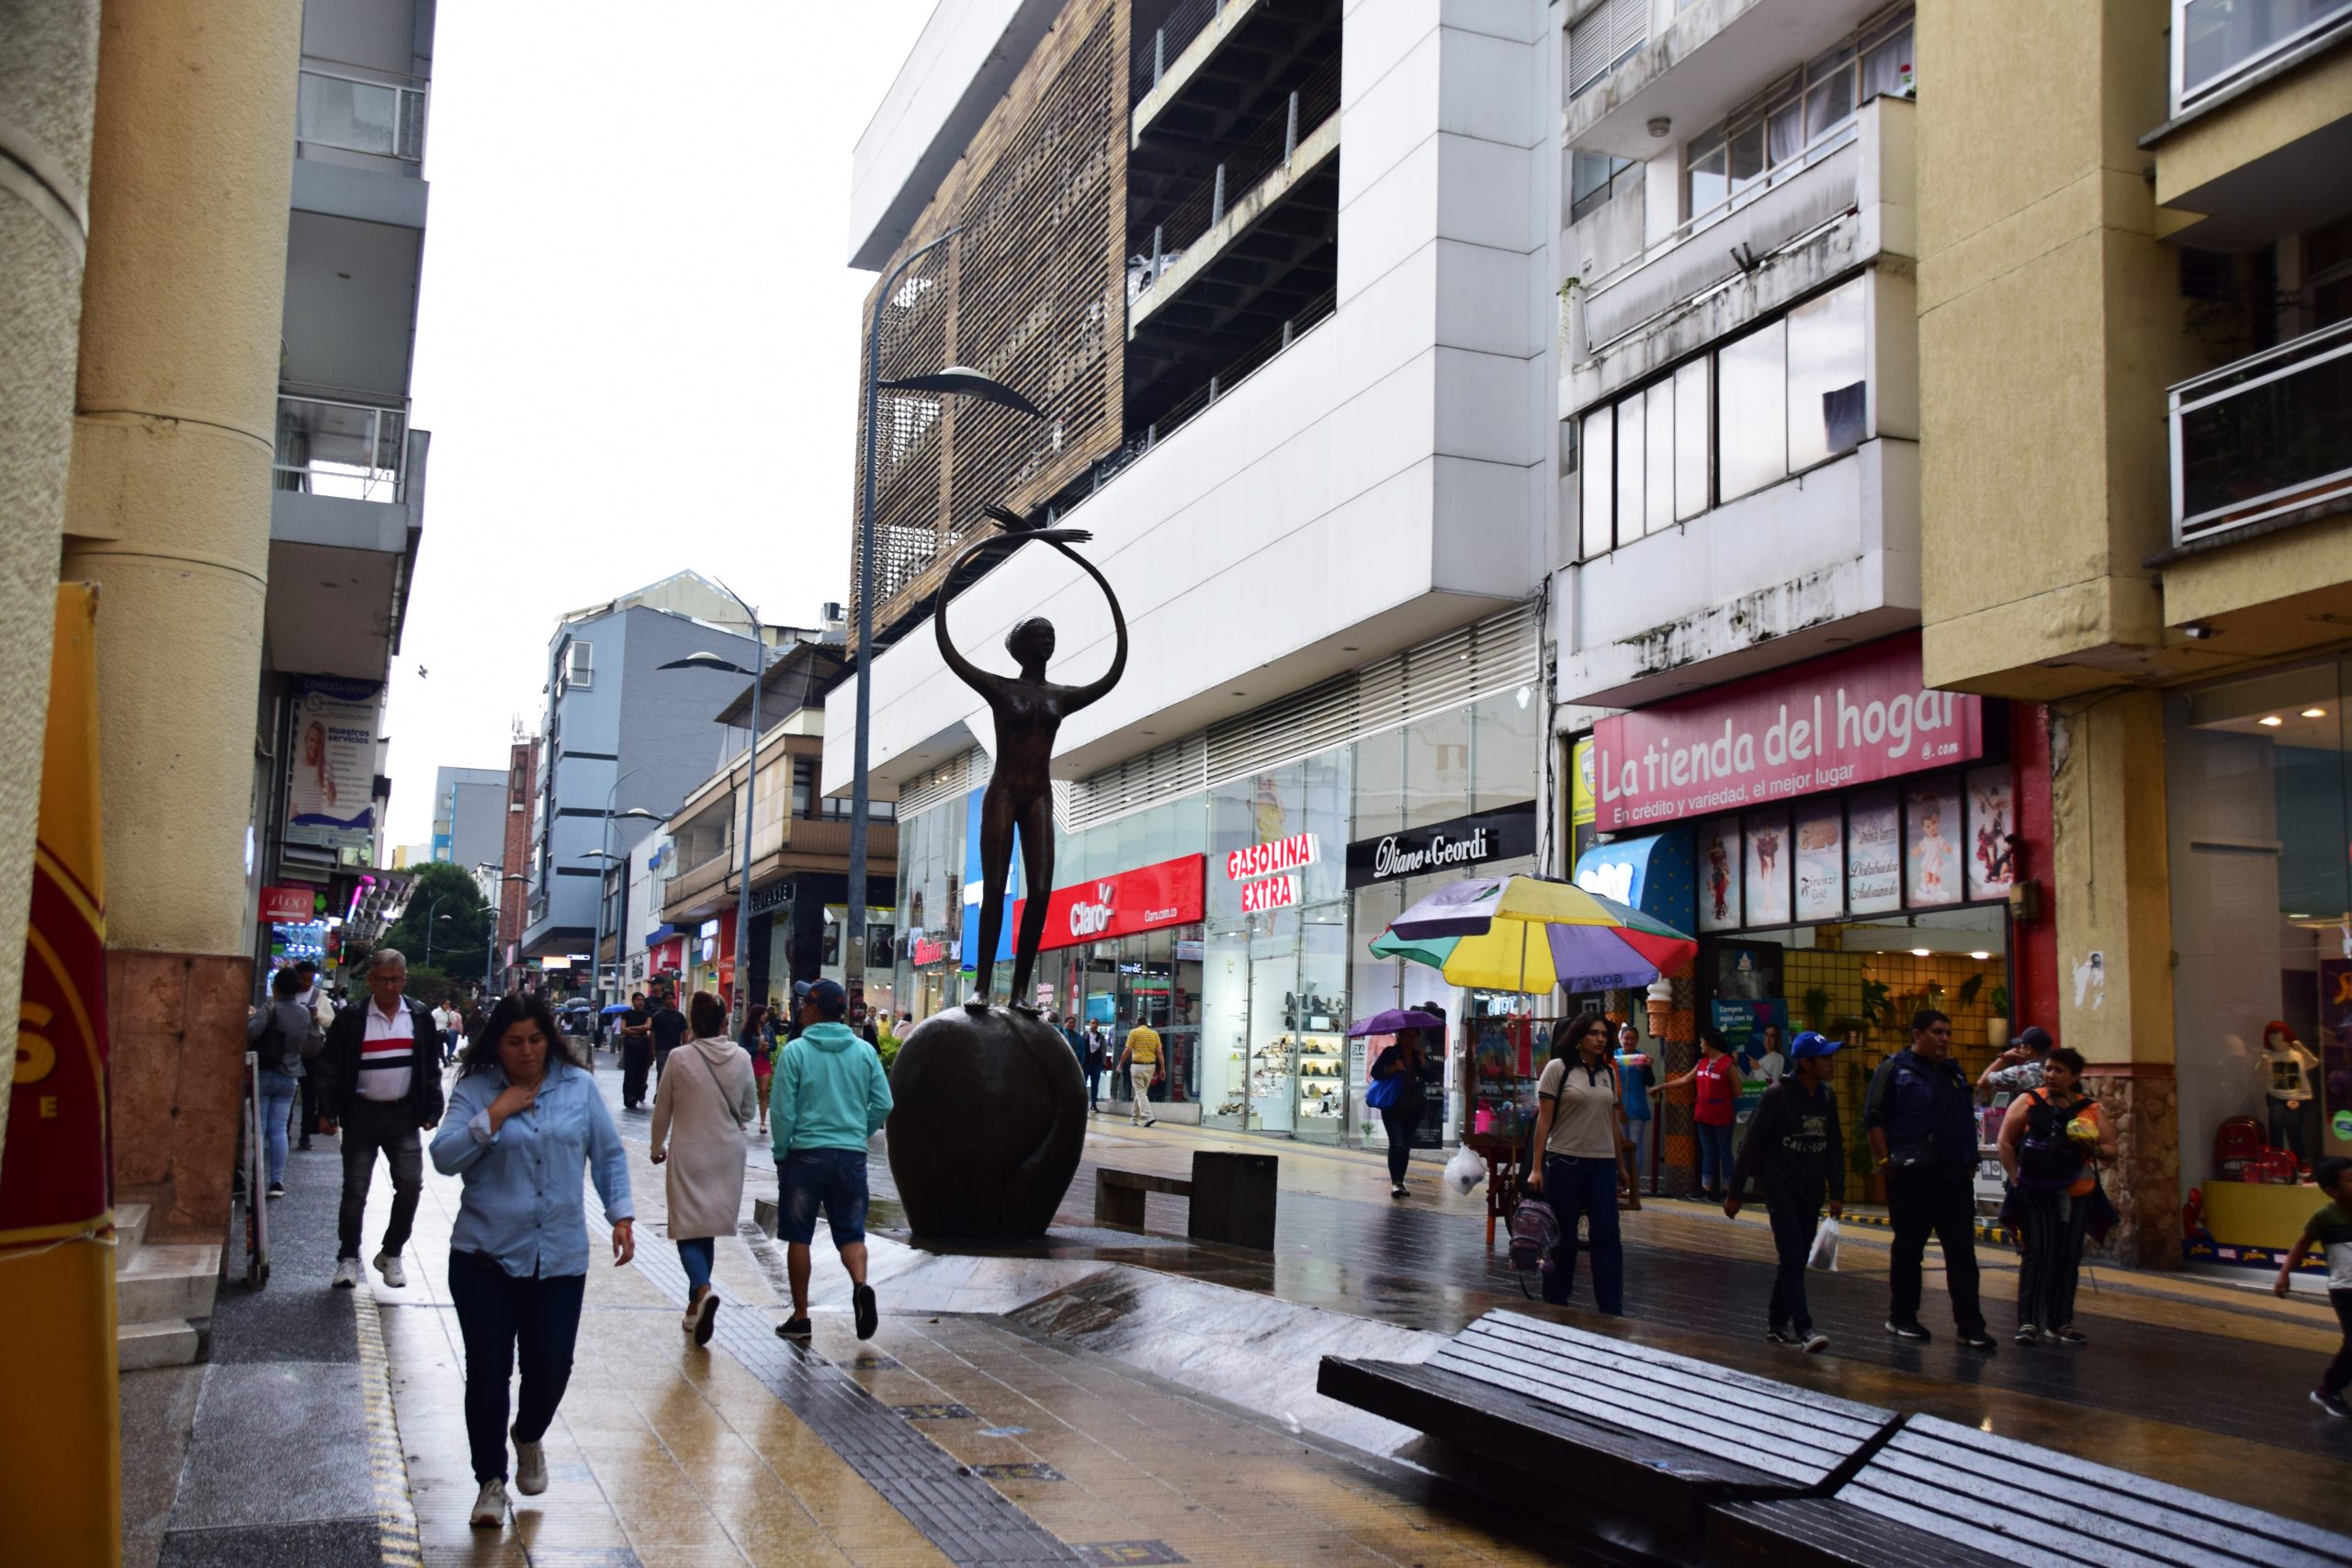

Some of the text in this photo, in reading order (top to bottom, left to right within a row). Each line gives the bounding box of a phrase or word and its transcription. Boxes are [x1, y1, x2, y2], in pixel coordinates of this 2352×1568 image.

[328, 727, 369, 737] Nuestros
[328, 734, 369, 744] servicios
[1602, 688, 1966, 803] La tienda del hogar
[1614, 807, 1629, 823] En
[1633, 799, 1674, 818] crédito
[1678, 800, 1685, 816] y
[1689, 784, 1748, 810] variedad,
[1753, 778, 1766, 797] el
[1770, 773, 1811, 795] mejor
[1815, 763, 1856, 788] lugar
[1227, 833, 1309, 881] GASOLINA
[1374, 836, 1424, 878] Diane
[1431, 828, 1487, 865] Geordi
[1241, 874, 1292, 912] EXTRA
[1070, 900, 1108, 937] Claro
[1145, 908, 1178, 923] Claro.com.co
[40, 1095, 58, 1119] E
